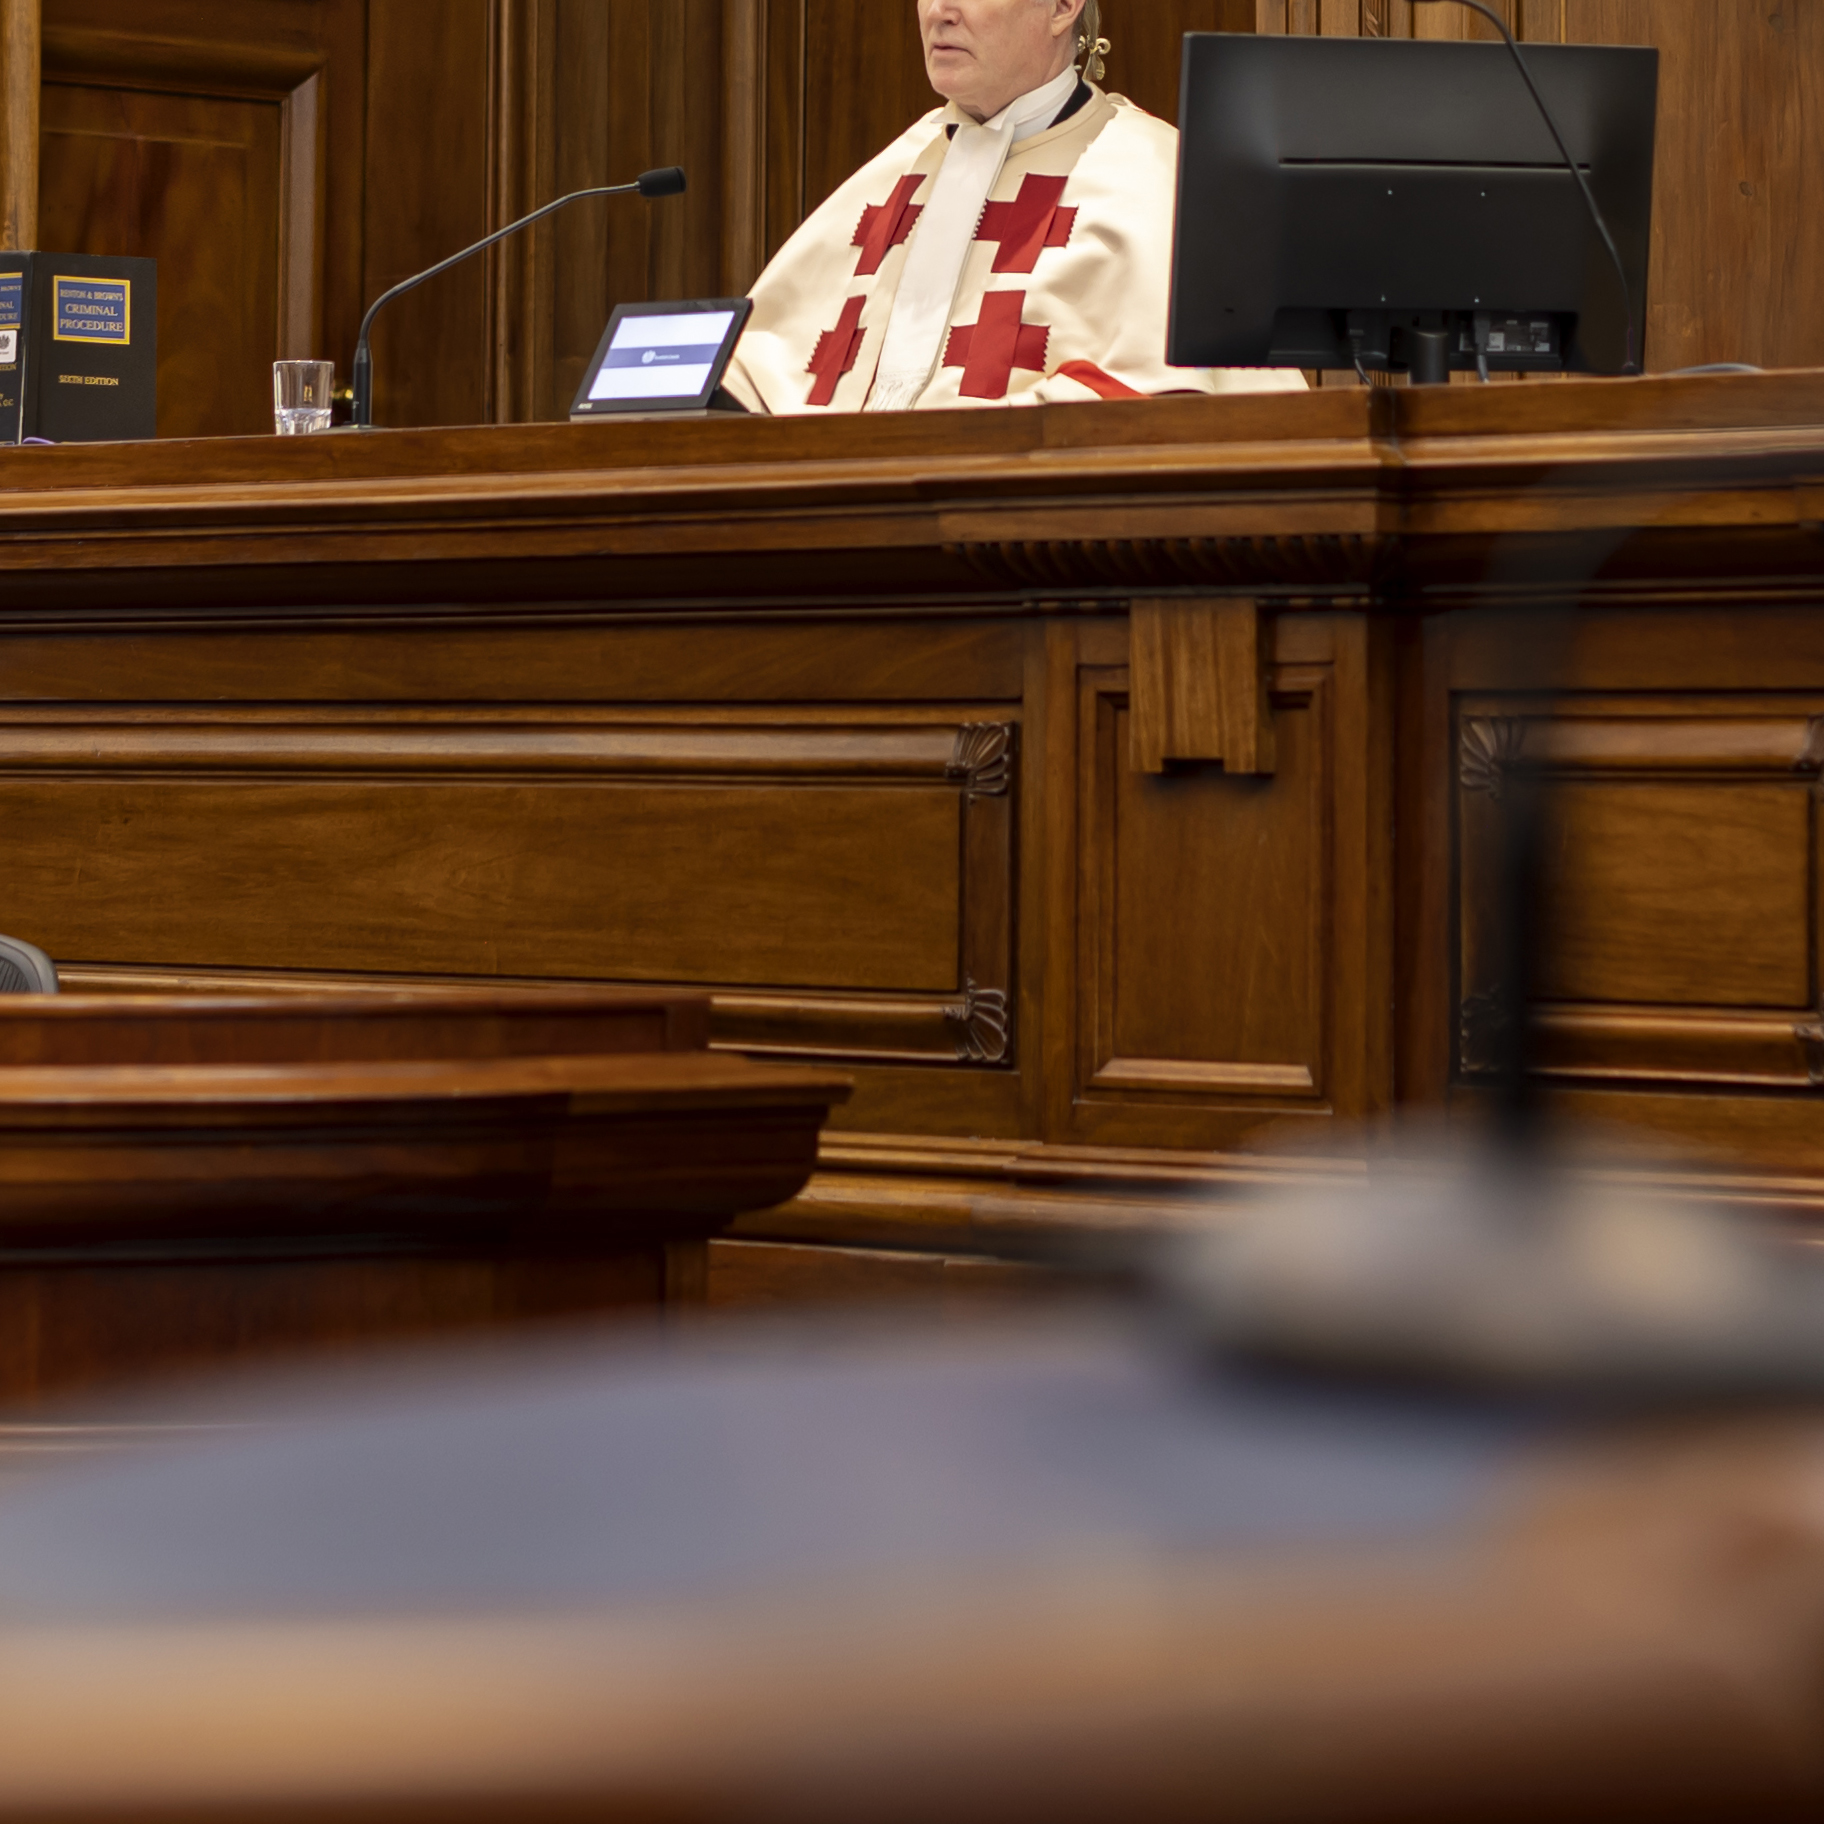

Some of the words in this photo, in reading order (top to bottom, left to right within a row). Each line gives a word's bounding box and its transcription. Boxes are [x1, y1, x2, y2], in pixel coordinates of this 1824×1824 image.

[65, 303, 119, 316] CRIMINAL
[60, 318, 124, 332] PROCEDURE
[84, 376, 119, 386] EDITION
